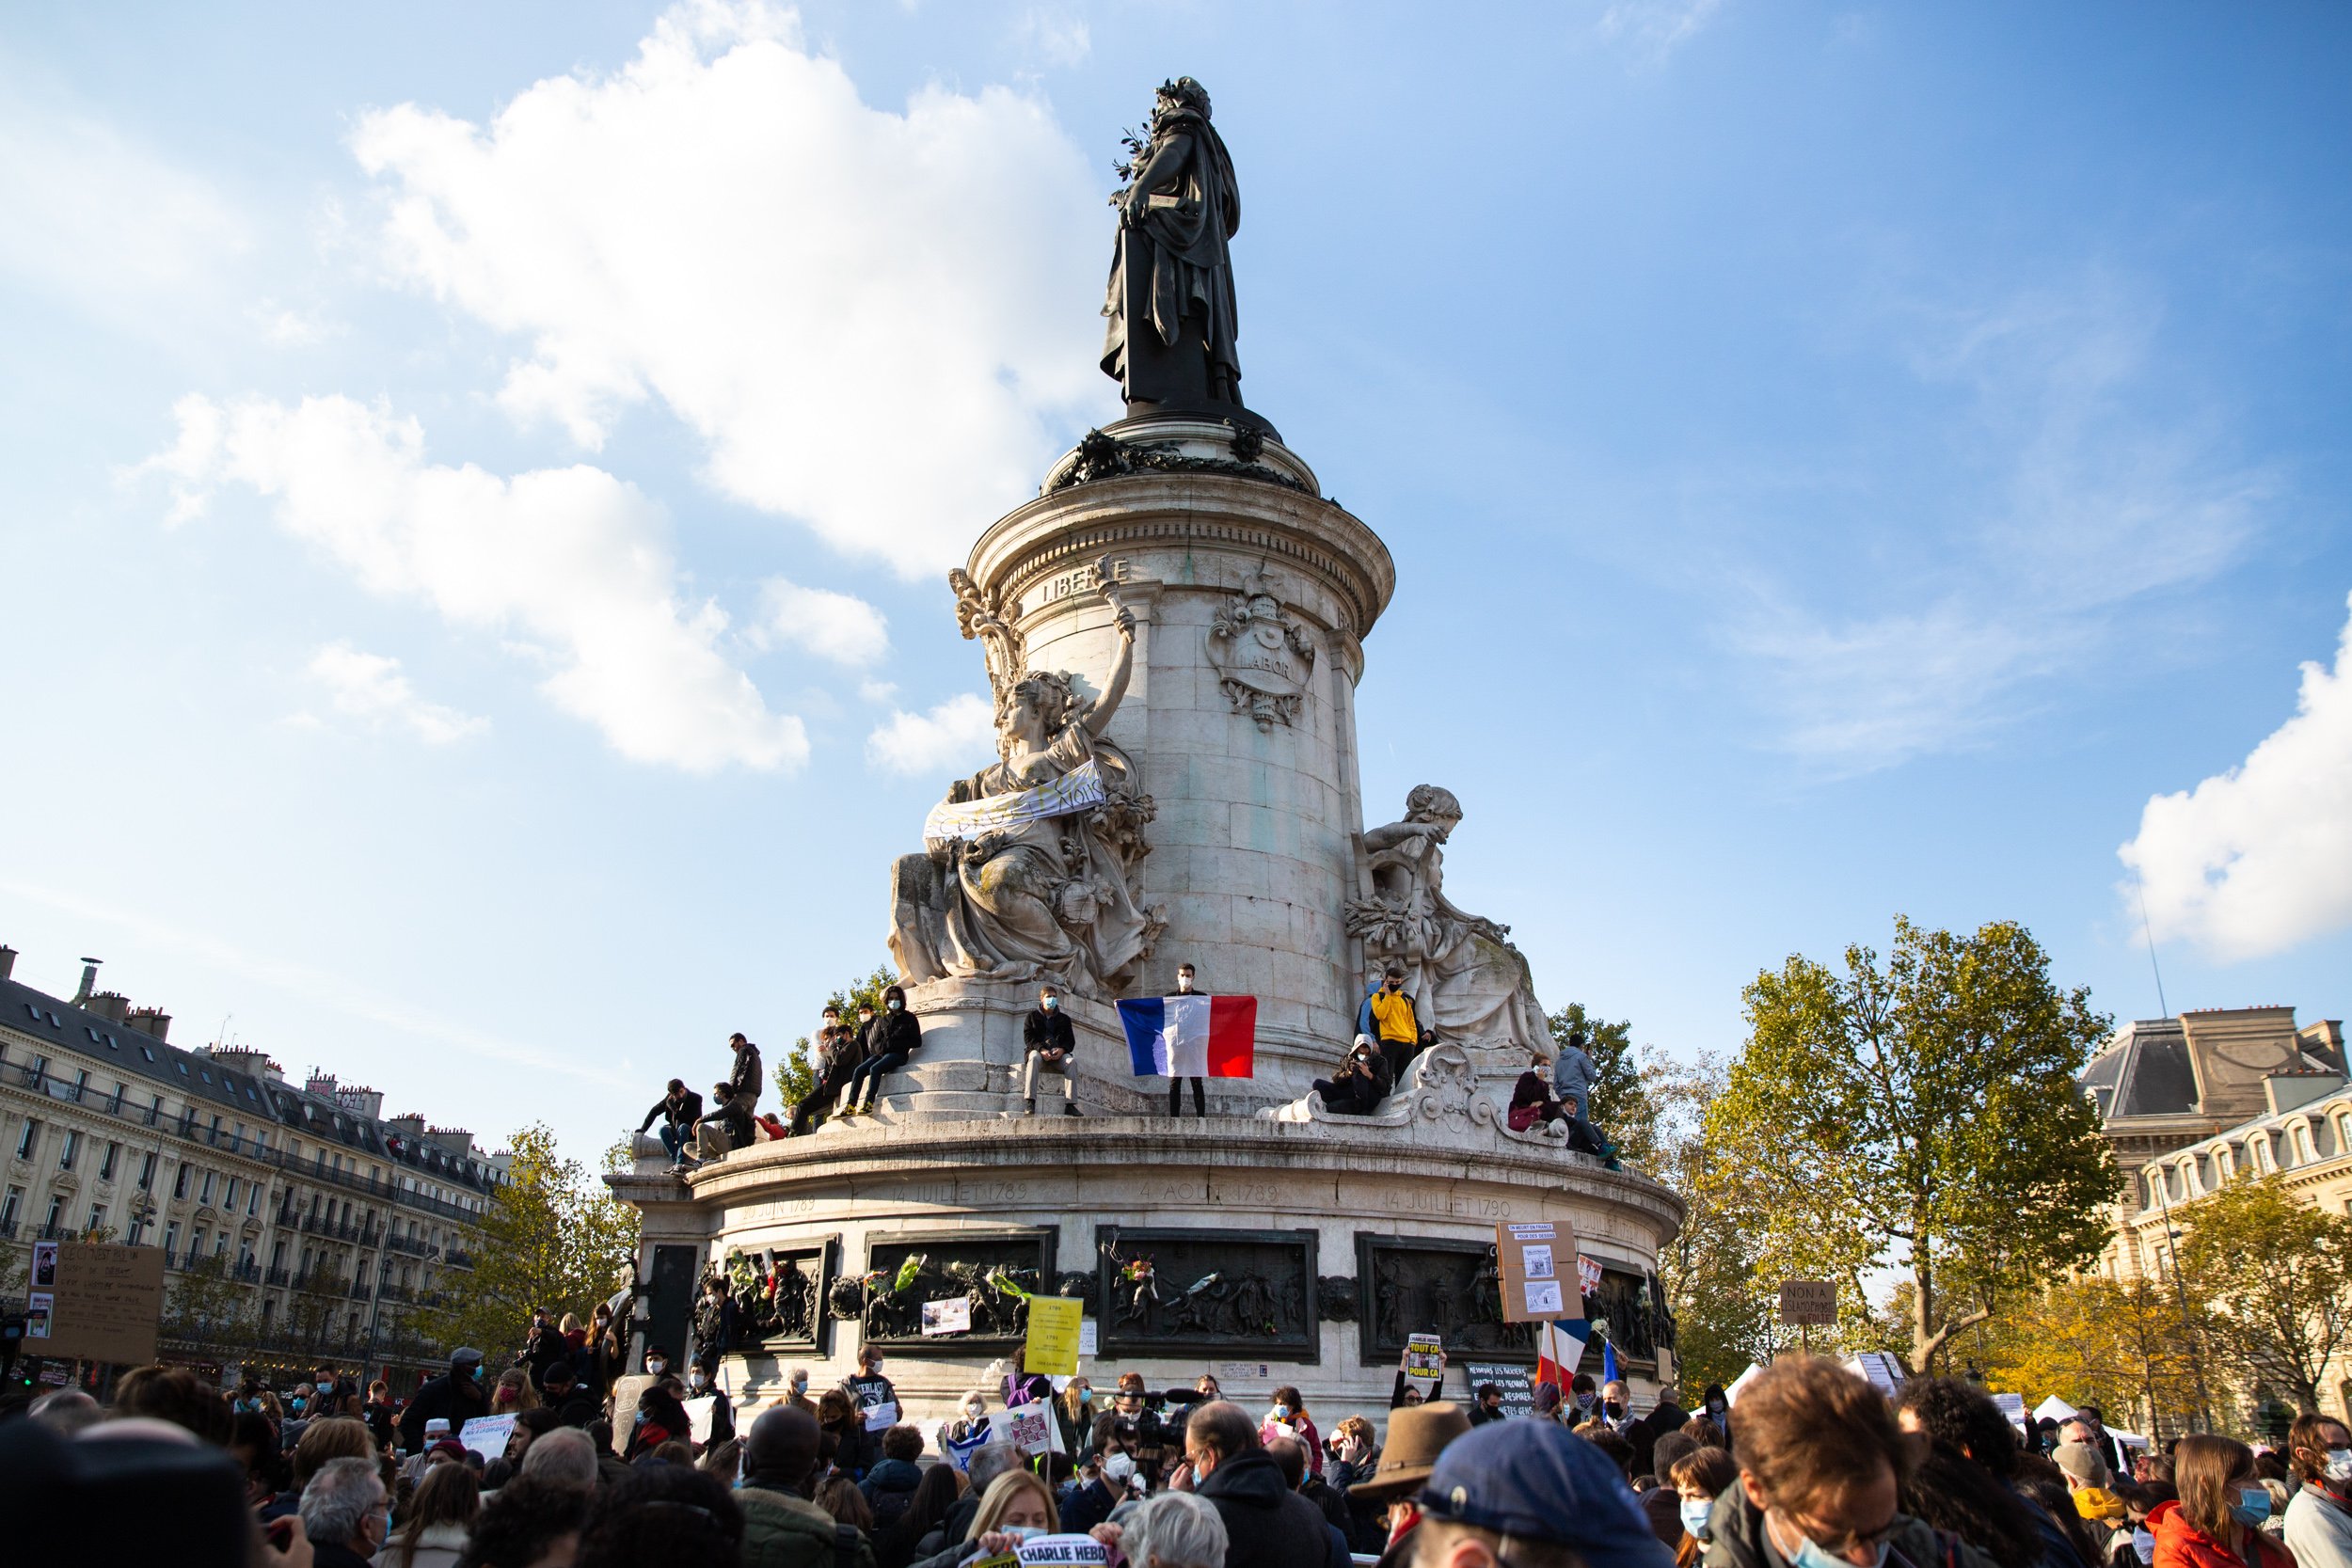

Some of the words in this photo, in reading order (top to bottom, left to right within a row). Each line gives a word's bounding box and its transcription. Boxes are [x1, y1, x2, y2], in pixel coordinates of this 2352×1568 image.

[1240, 654, 1291, 679] LABOR
[1058, 779, 1104, 813] NOUS
[892, 1187, 905, 1203] 14
[912, 1183, 981, 1203] JUILLET
[989, 1182, 1027, 1200] 1789
[1139, 1181, 1150, 1199] 4
[1237, 1184, 1279, 1202] 1789
[758, 1197, 785, 1217] JUIN
[790, 1195, 816, 1213] 1789
[1386, 1191, 1399, 1209] 14
[1406, 1192, 1472, 1214] JUILLET
[1478, 1197, 1511, 1217] 1790
[1788, 1287, 1814, 1298] NON
[1820, 1288, 1826, 1299] A
[1807, 1312, 1833, 1323] FOLIE
[1410, 1343, 1429, 1354] TOUT
[1408, 1367, 1428, 1376] POUR
[1494, 1367, 1503, 1375] LES
[1495, 1379, 1504, 1387] LES
[1518, 1406, 1534, 1416] GENS
[1019, 1545, 1073, 1561] CHARLIE
